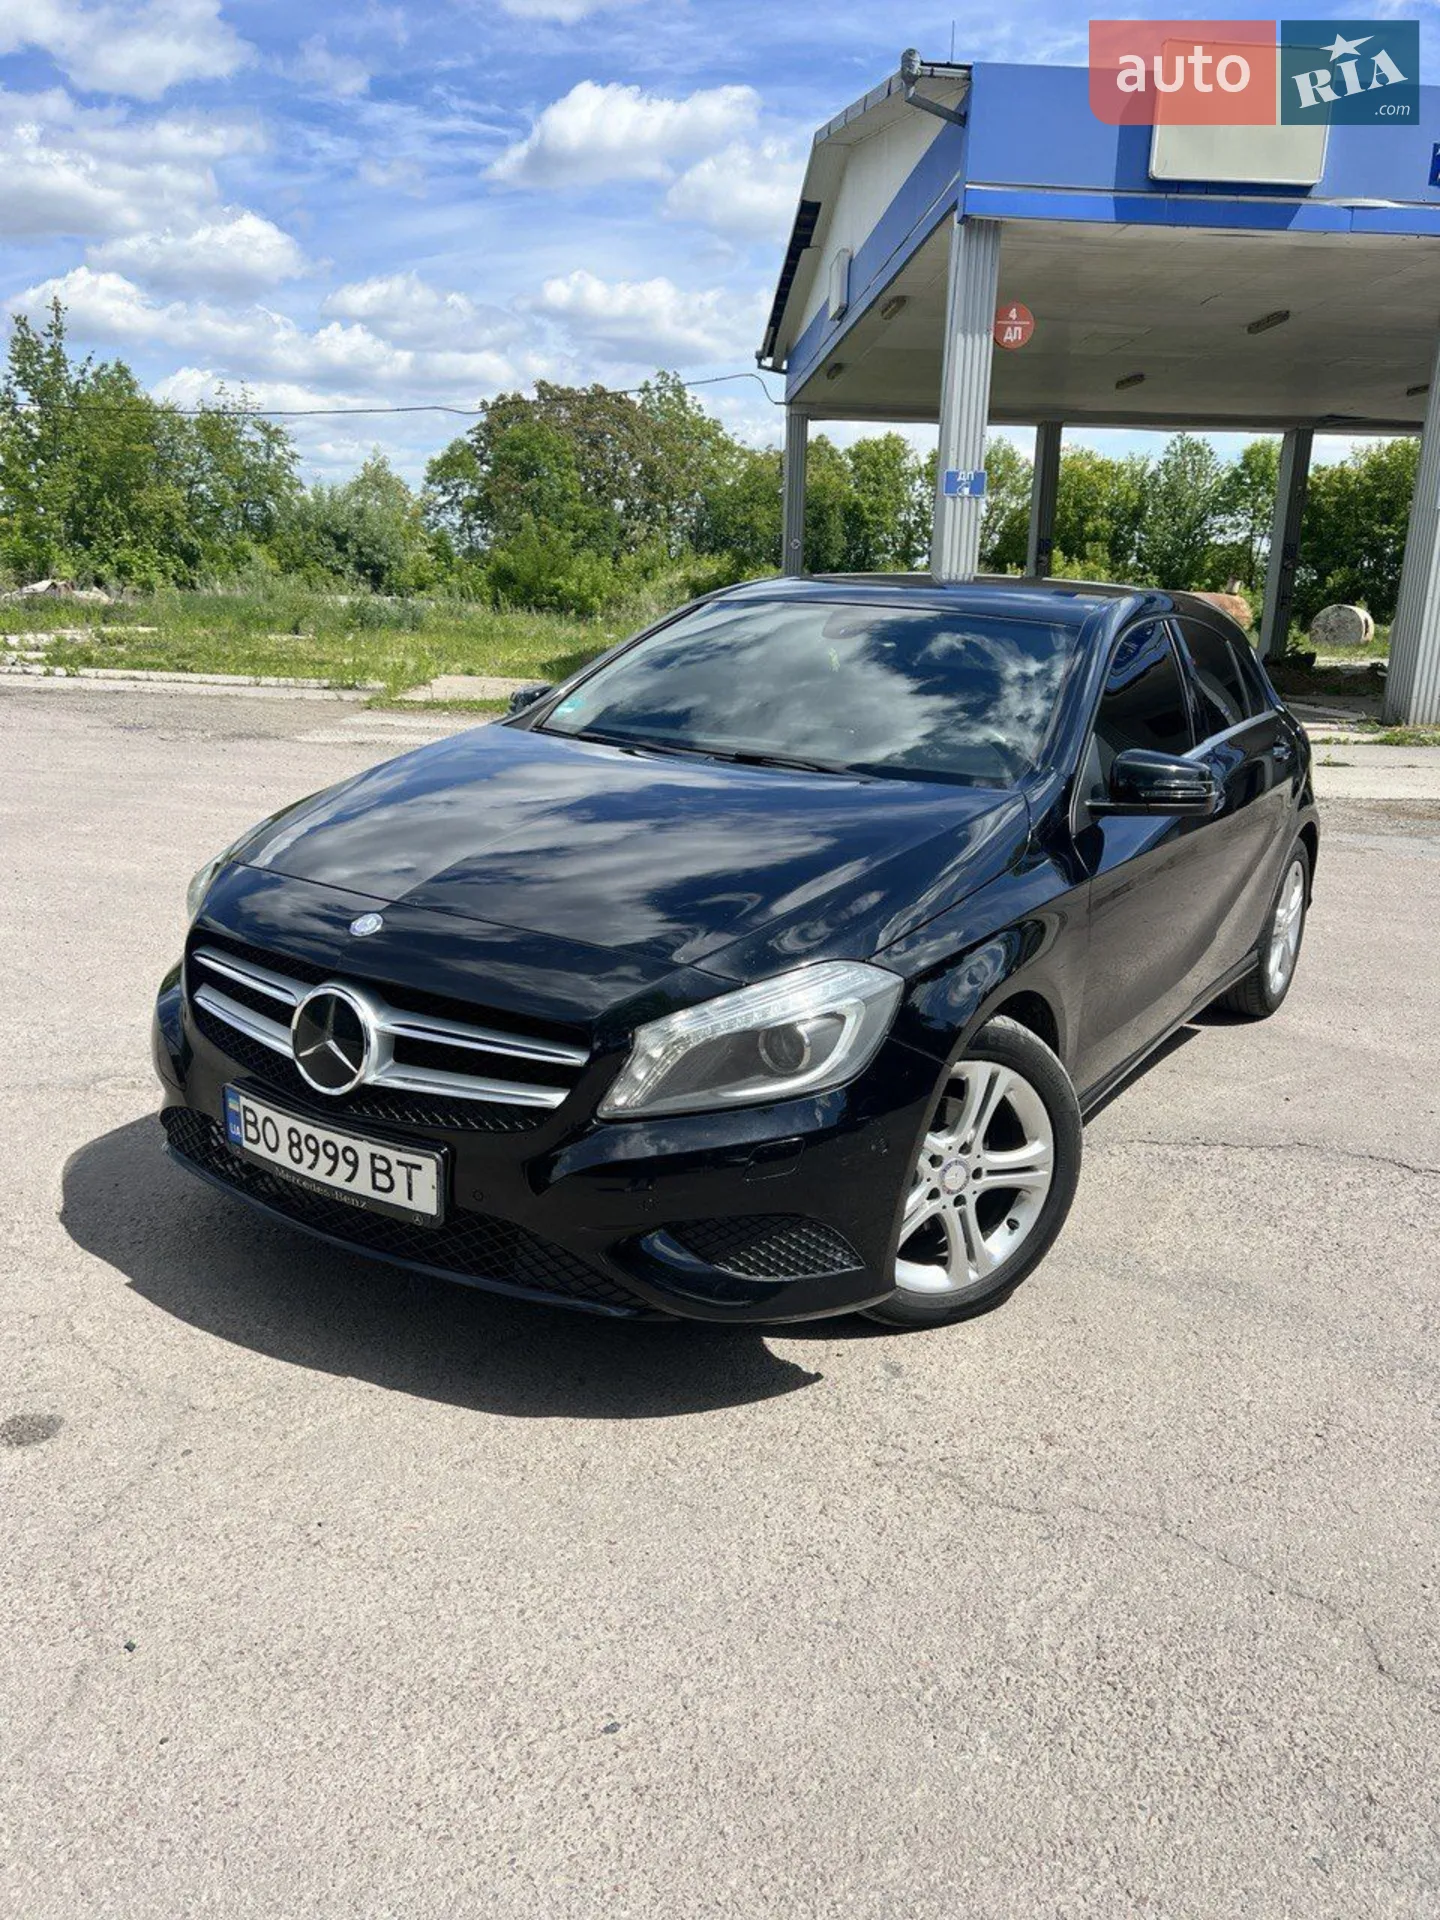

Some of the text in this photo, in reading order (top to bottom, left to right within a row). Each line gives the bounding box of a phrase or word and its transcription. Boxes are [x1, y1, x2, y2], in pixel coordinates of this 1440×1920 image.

[1008, 308, 1017, 320] 4
[1003, 326, 1022, 342] ДП
[229, 1122, 241, 1137] UA
[287, 1127, 359, 1182] 8999
